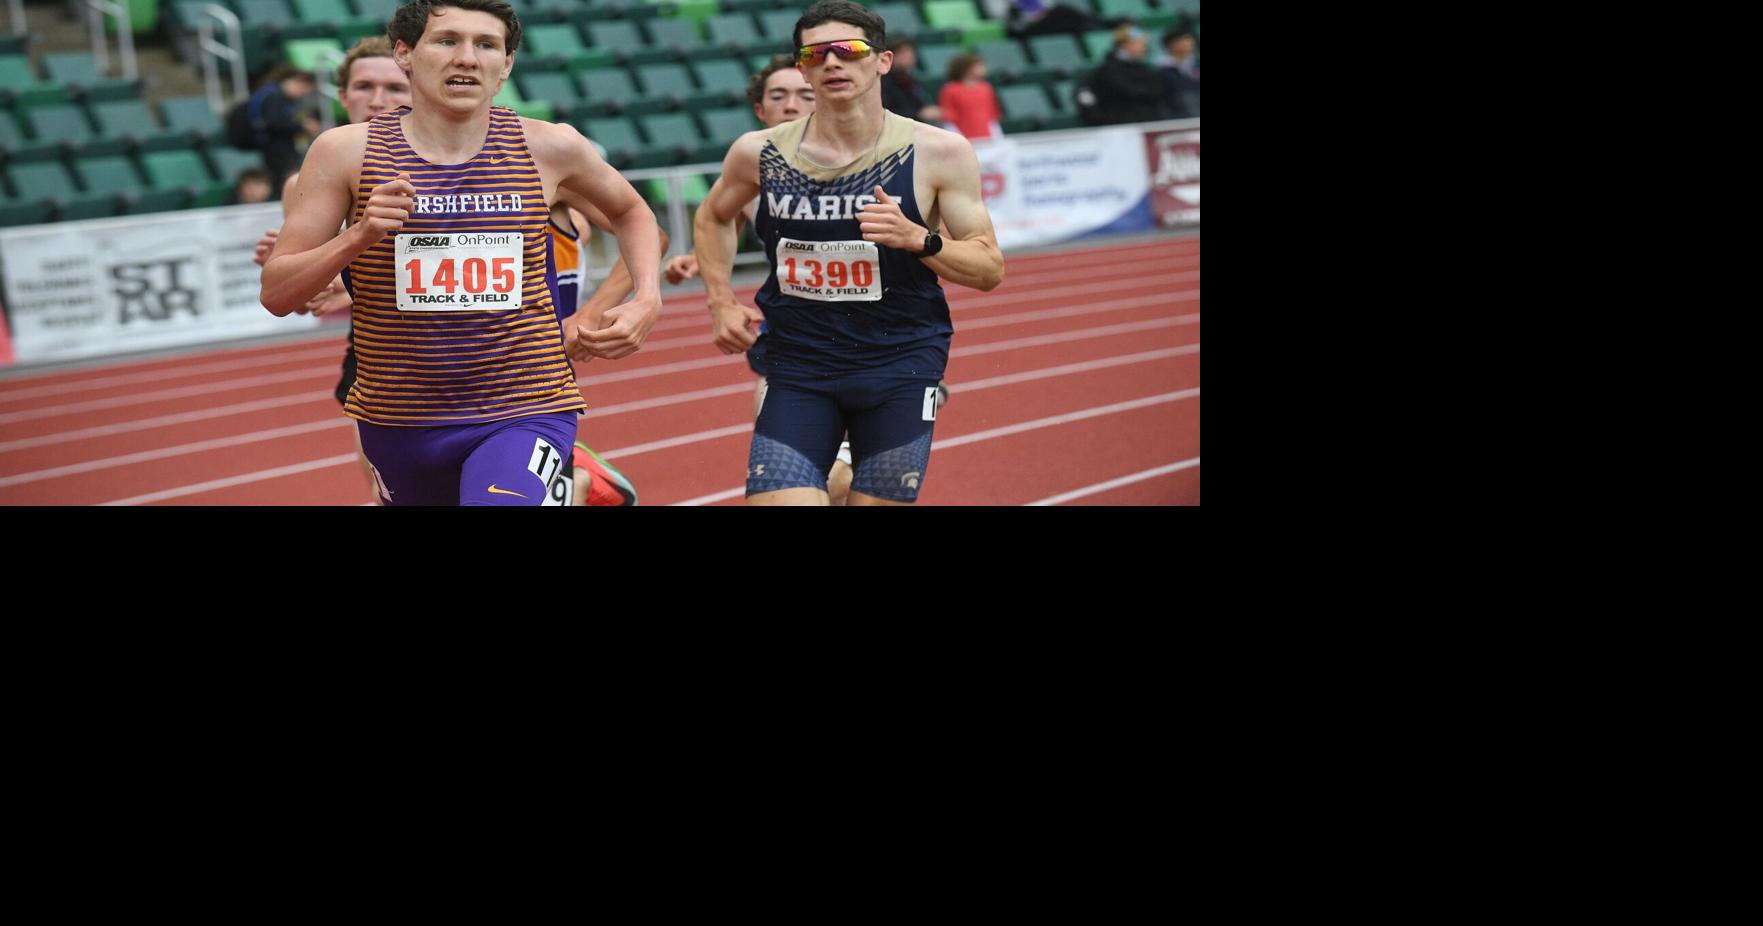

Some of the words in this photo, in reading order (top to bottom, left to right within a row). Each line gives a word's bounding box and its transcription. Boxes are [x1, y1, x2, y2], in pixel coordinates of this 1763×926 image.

[417, 194, 522, 214] RSHFIELD
[410, 236, 450, 247] OSAA
[457, 234, 510, 245] OnPoint
[784, 241, 815, 251] OSAA
[820, 243, 865, 252] OnPoint
[405, 257, 515, 294] 1405
[784, 257, 873, 288] 1390
[790, 284, 822, 295] TRACK
[825, 287, 834, 295] &
[837, 287, 868, 295] FIELD
[410, 295, 455, 303] TRACK
[459, 294, 469, 303] &
[473, 294, 509, 303] FIELD
[537, 445, 561, 488] 11
